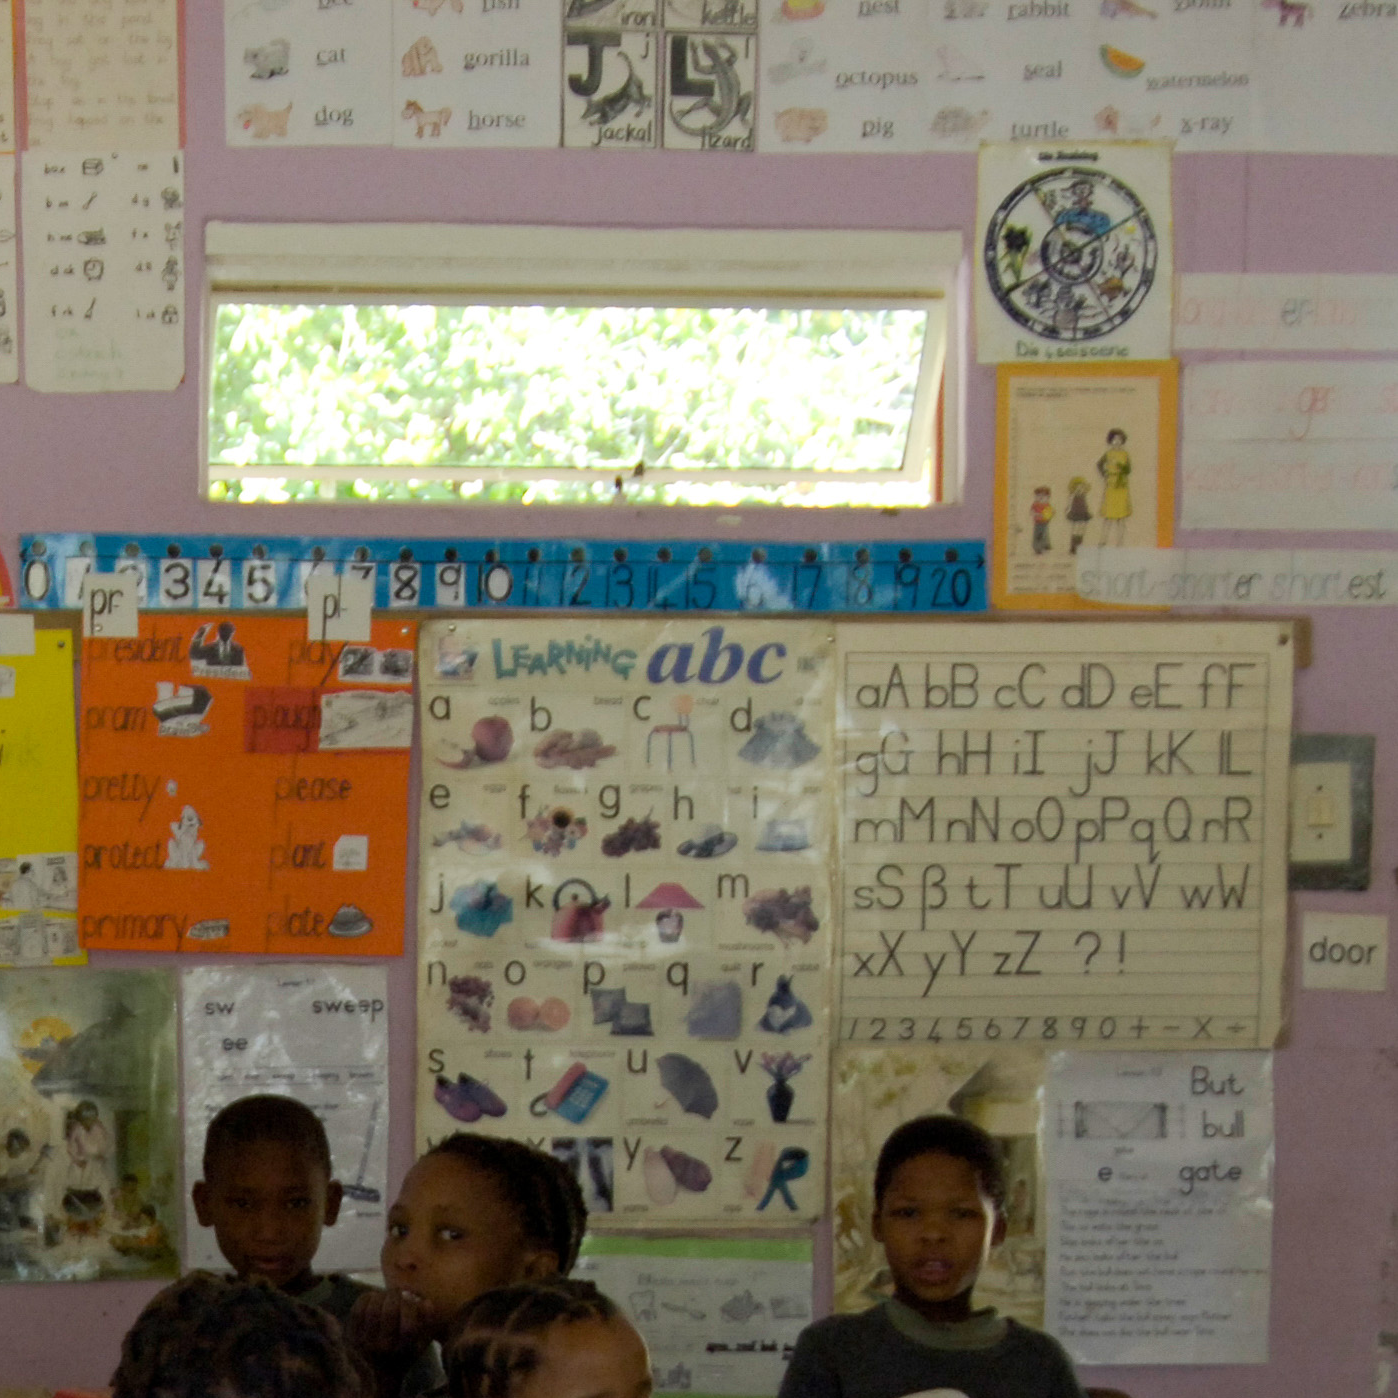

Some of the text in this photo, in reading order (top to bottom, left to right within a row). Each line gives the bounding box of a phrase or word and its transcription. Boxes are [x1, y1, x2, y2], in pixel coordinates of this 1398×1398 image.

[620, 6, 657, 28] iron
[1006, 1, 1070, 22] rabbit
[315, 48, 346, 67] cat
[463, 49, 530, 71] gorilla
[566, 32, 622, 97] J
[670, 35, 715, 97] L
[835, 66, 919, 89] octopus
[1022, 61, 1062, 80] seal
[1145, 71, 1250, 91] watermelon
[314, 106, 354, 128] dog
[467, 109, 527, 131] horse
[861, 116, 895, 139] pig
[1180, 113, 1235, 135] x-ray
[592, 122, 653, 147] jackal
[1010, 120, 1070, 142] turtle
[22, 558, 51, 602] 0
[163, 563, 191, 600] 3
[203, 560, 229, 603] 4
[247, 565, 273, 602] 5
[392, 563, 419, 601] 8
[440, 564, 463, 600] 9
[476, 562, 513, 603] 10
[604, 564, 634, 609] 13
[931, 566, 972, 608] 20
[646, 626, 787, 685] abc
[855, 663, 1257, 710] aA bB cC dD eE fF
[429, 695, 753, 732] a b c d
[429, 783, 759, 821] e f g h i
[853, 863, 1250, 911] sS tT uU vV wW
[1309, 936, 1378, 965] door
[852, 929, 1102, 998] xX yY zZ ?
[204, 1001, 236, 1016] sw
[311, 999, 385, 1023] sweep
[222, 1037, 249, 1052] ee
[1190, 1065, 1245, 1096] But
[1203, 1110, 1245, 1139] bull
[1178, 1159, 1243, 1196] gate
